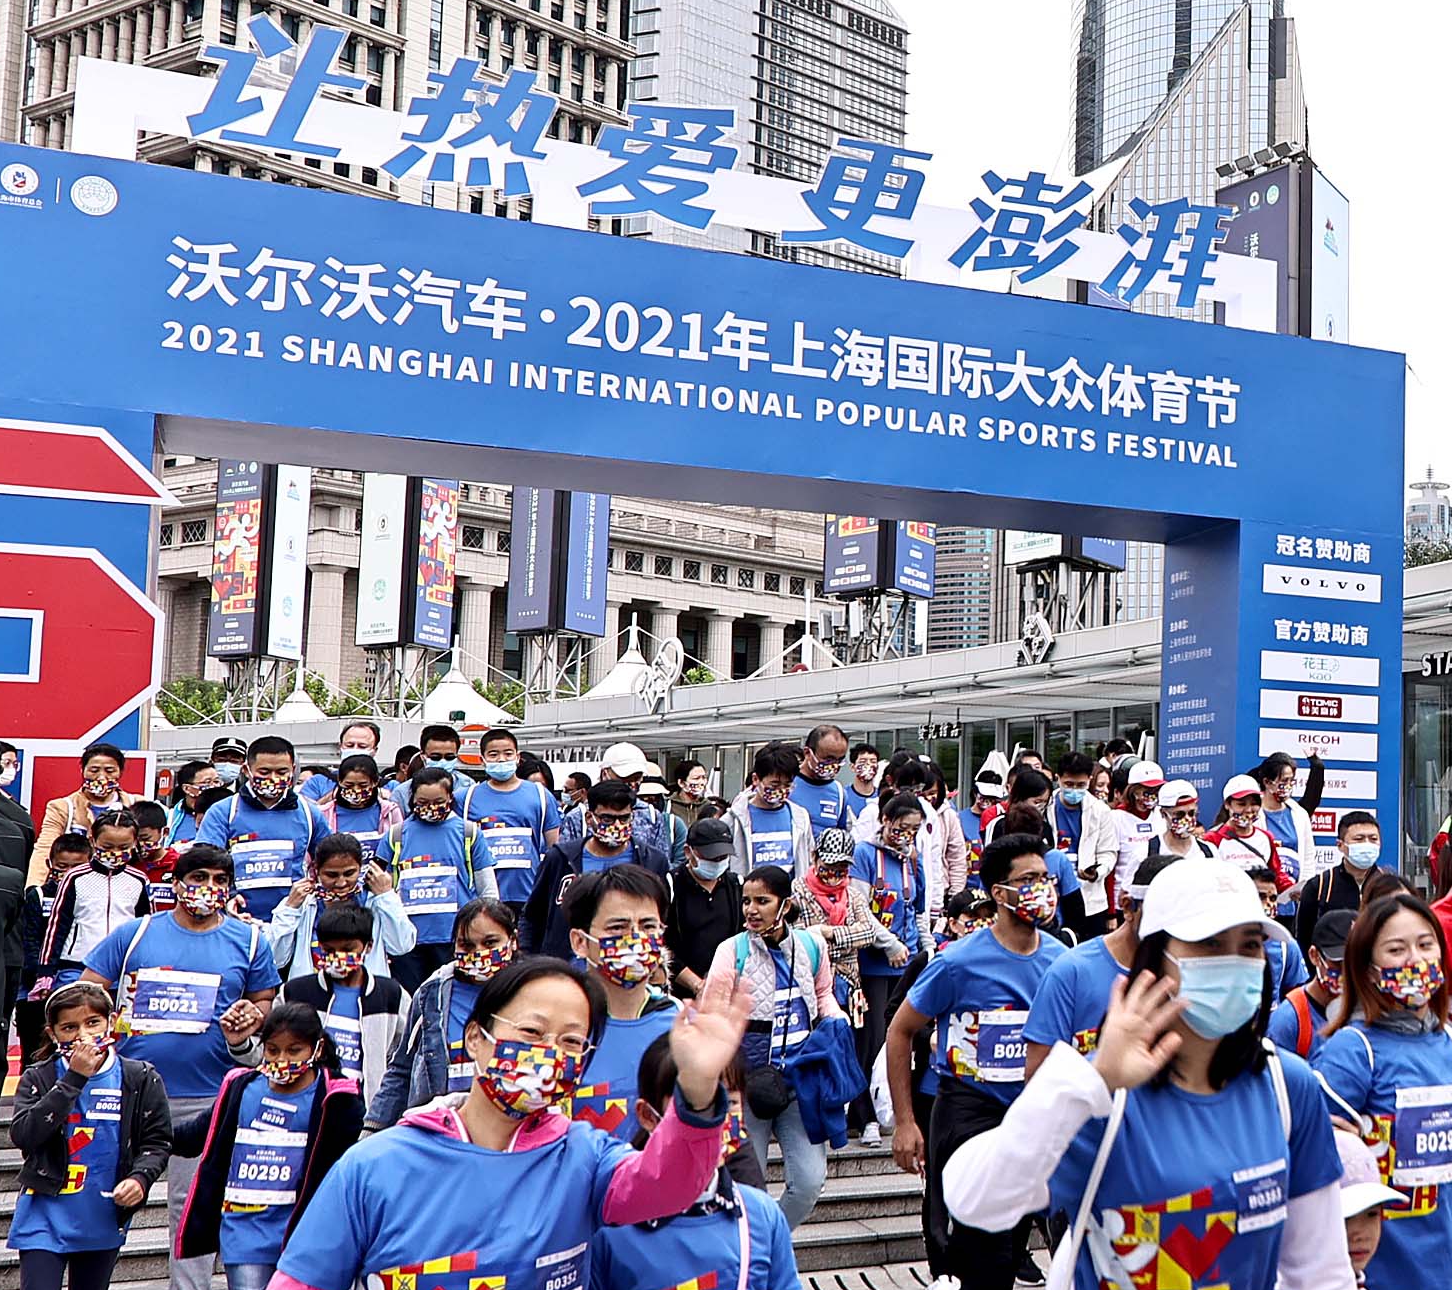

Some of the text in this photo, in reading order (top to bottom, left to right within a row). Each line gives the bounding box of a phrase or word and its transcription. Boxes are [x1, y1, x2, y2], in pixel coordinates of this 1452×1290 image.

[185, 12, 1234, 309] 让热爱更澎湃
[165, 235, 1240, 426] 沃尔沃汽车·2021年上海国际大众体育节
[160, 321, 1237, 469] 2021 SHANGHAI INTERNATIONAL POPULAR SPORTS FESTIVAL
[1276, 535, 1371, 564] 冠名赞助商
[1280, 575, 1366, 592] VOLVO
[1274, 619, 1369, 646] 官方赞助商
[1303, 657, 1328, 670] 花王
[1298, 734, 1340, 745] RICOH
[755, 849, 788, 862] B0544
[245, 861, 285, 874] B0374
[409, 888, 448, 900] B0373
[148, 997, 198, 1013] B0021
[336, 1045, 360, 1062] 023
[993, 1043, 1027, 1060] B028
[238, 1163, 291, 1181] B0298
